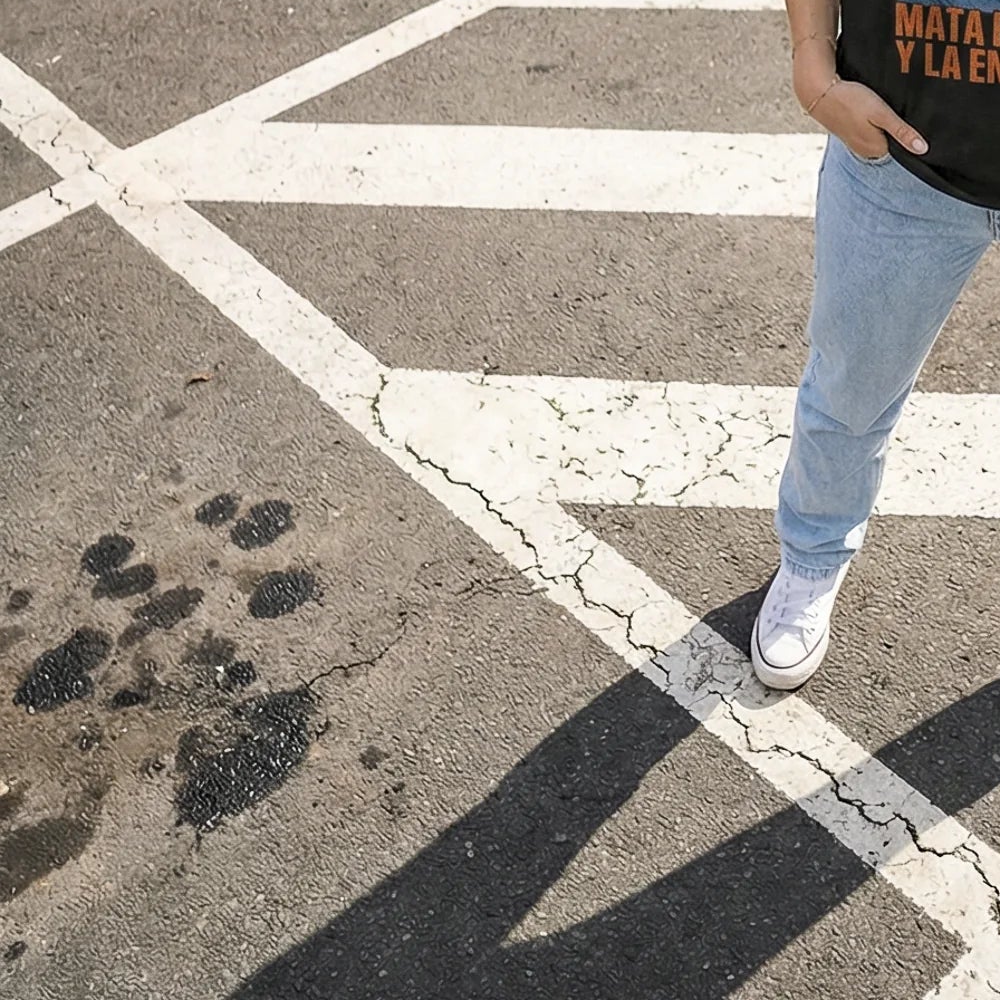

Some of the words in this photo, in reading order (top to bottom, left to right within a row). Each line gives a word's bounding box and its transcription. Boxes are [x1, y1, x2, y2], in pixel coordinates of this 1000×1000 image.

[895, 2, 985, 46] MATA
[895, 40, 915, 73] Y
[924, 43, 962, 80] LA
